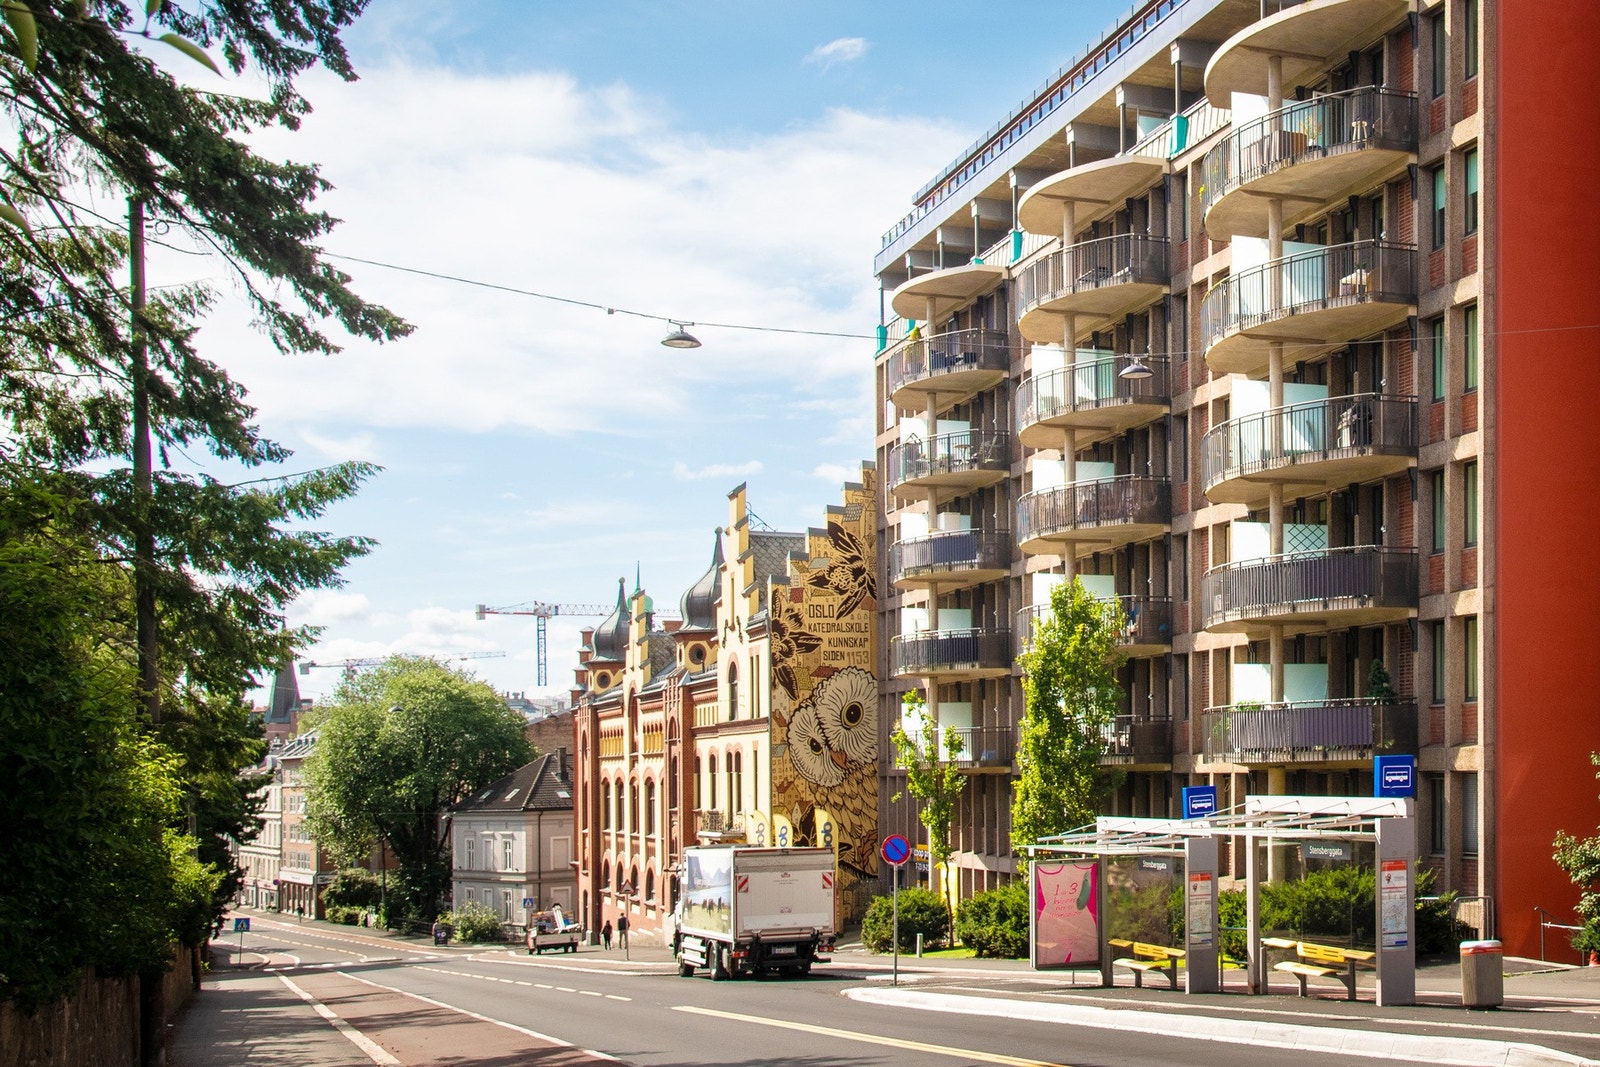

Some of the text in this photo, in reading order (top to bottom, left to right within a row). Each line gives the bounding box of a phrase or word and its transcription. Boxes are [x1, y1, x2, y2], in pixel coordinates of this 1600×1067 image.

[808, 604, 835, 619] OSLO
[808, 622, 869, 633] KATEDRALSKOLE
[828, 637, 869, 648] KUNNSKAP
[823, 650, 869, 665] SIDEN 1153
[1309, 845, 1343, 857] Stensberggata
[1054, 884, 1060, 896] 1
[1068, 882, 1079, 895] 3
